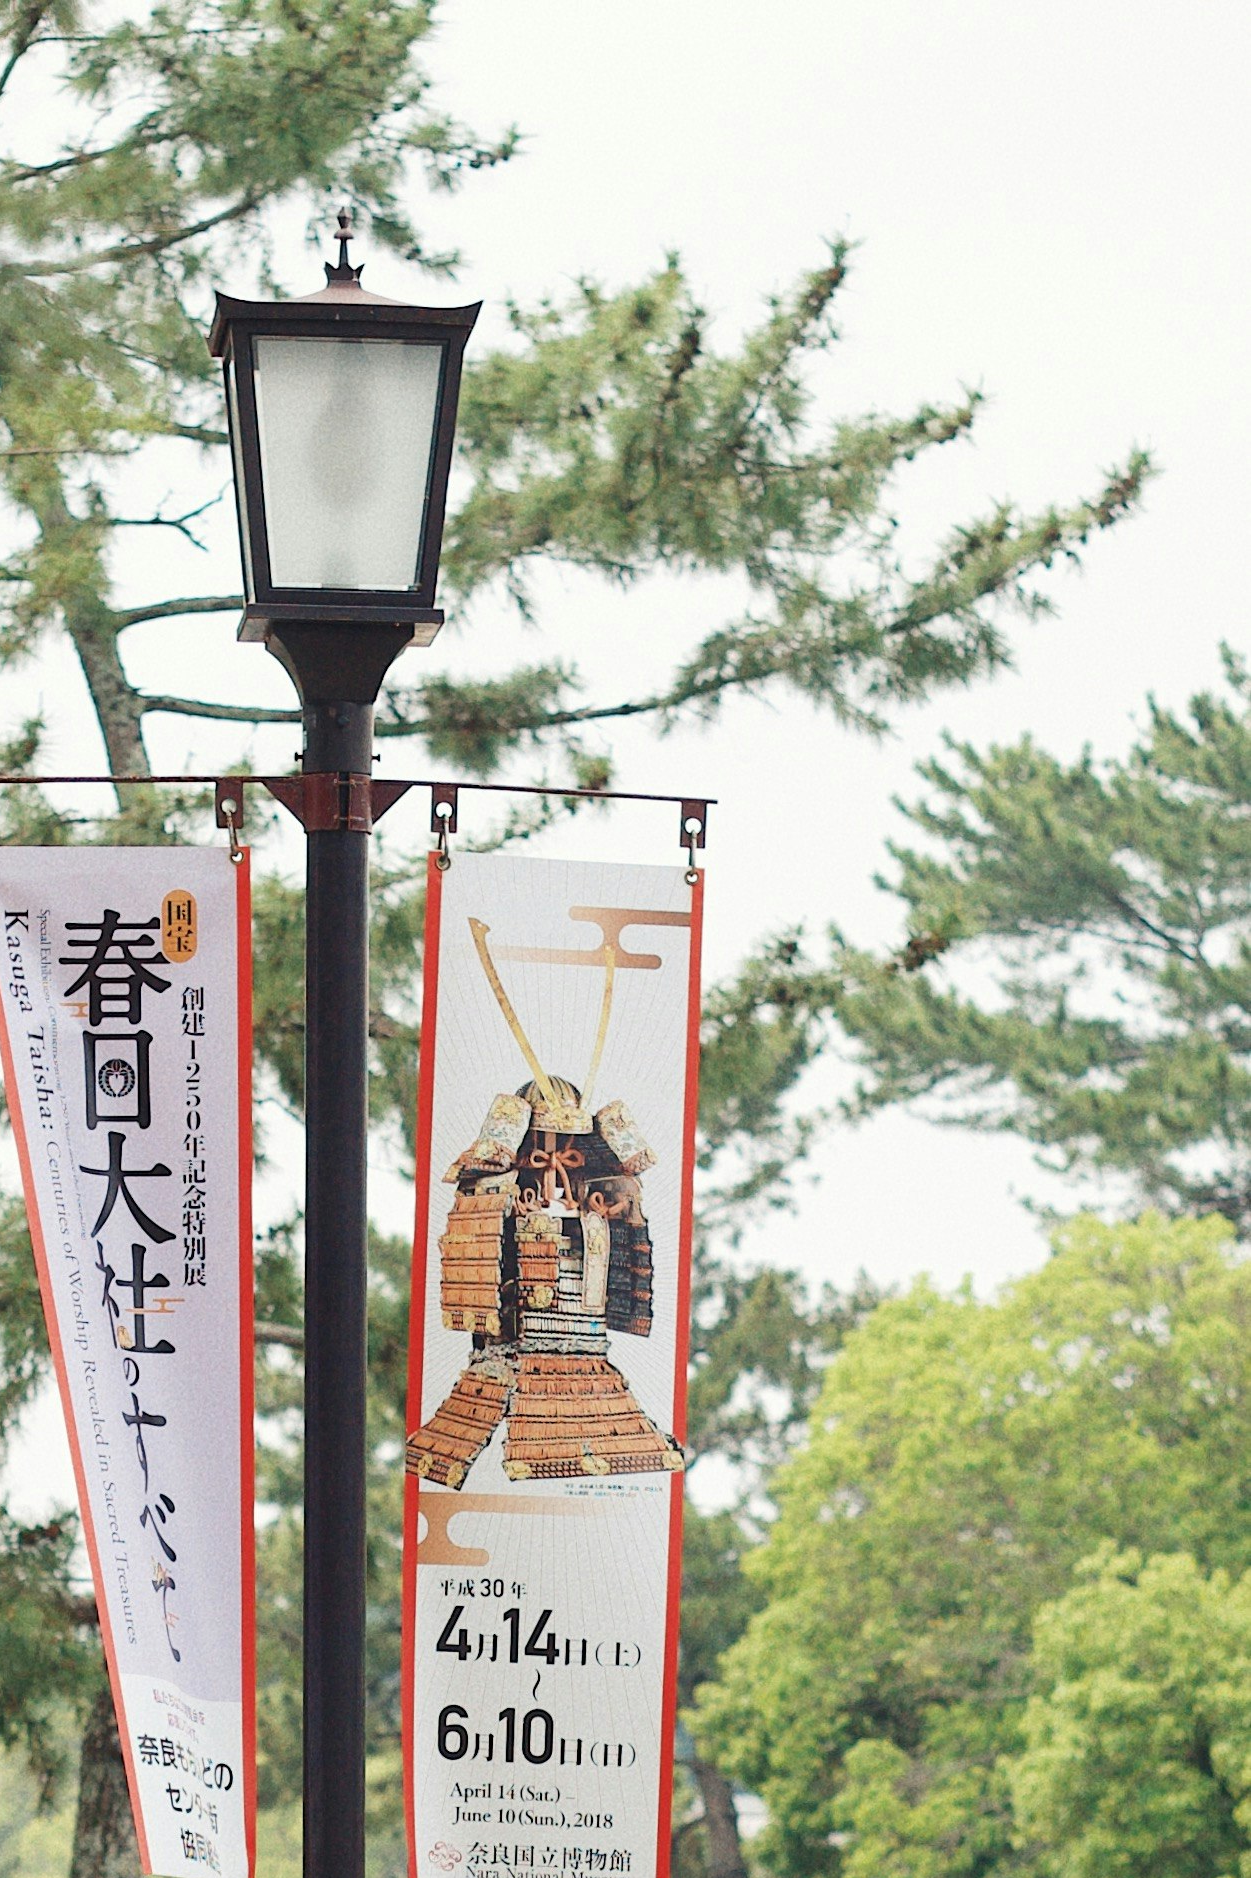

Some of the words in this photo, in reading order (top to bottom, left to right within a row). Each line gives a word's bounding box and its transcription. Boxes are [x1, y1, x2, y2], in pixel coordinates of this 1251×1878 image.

[37, 908, 51, 945] Special
[165, 899, 193, 955] 国宝
[4, 909, 33, 1013] Kasuga
[27, 1027, 54, 1130] Taisha:
[181, 985, 208, 1288] 創建1250年記念特別展
[46, 1141, 70, 1235] Centuries
[63, 1241, 79, 1264] of
[68, 1269, 88, 1351] Worship
[83, 1359, 109, 1447] Revealed
[98, 1453, 111, 1474] in
[103, 1480, 125, 1545] Sacred
[115, 1552, 138, 1645] Treasures
[450, 1782, 492, 1803] April
[498, 1784, 515, 1800] 14
[519, 1784, 561, 1804] (Sat.)
[452, 1806, 492, 1826] June
[467, 1841, 632, 1872] 奈良国立博物館
